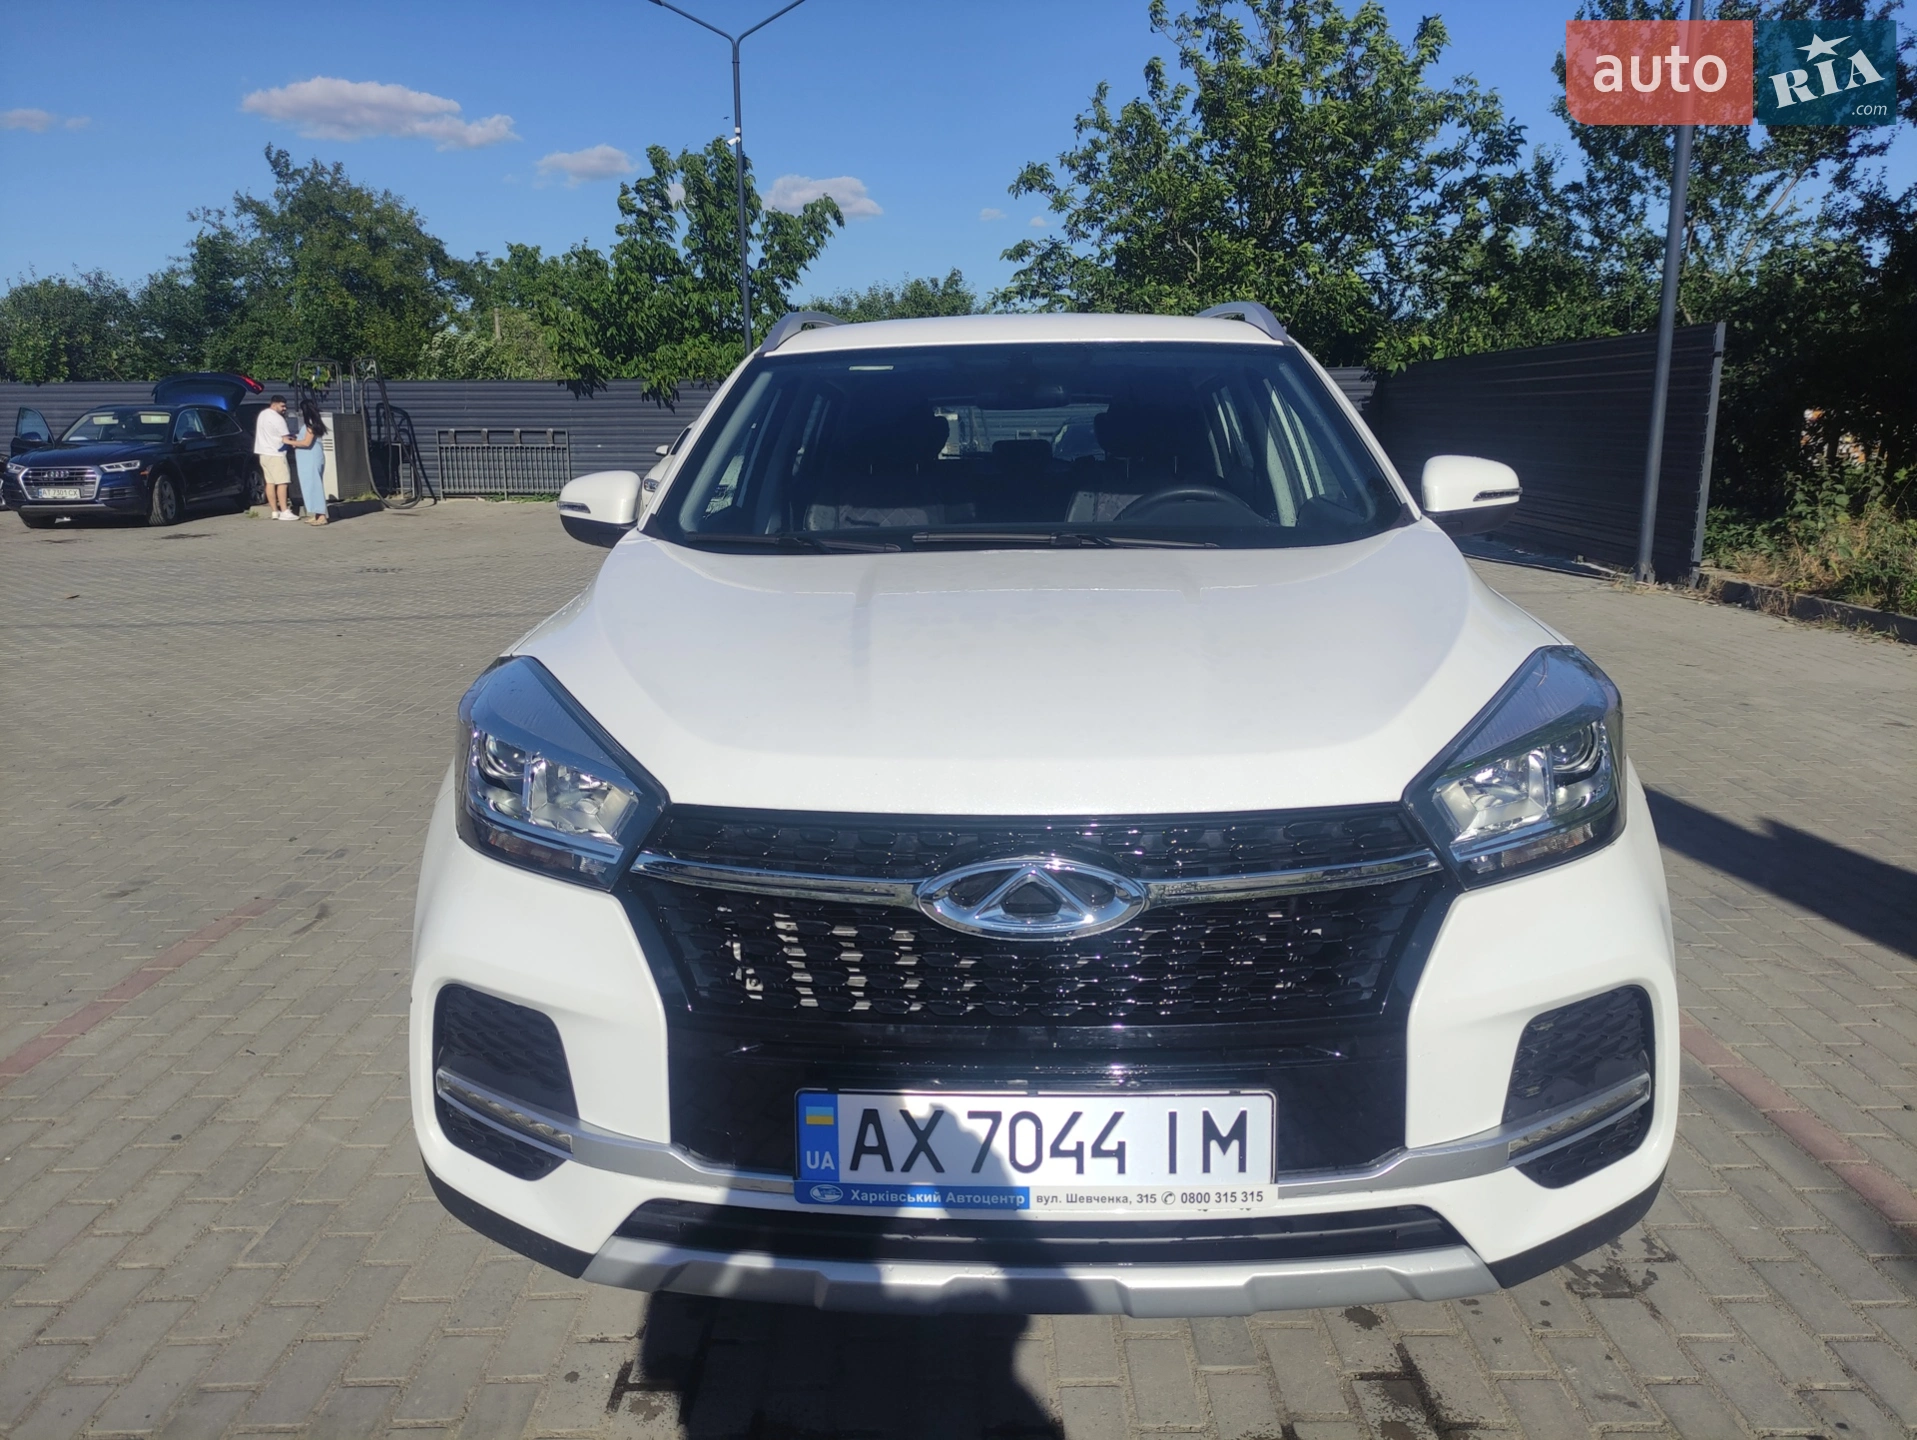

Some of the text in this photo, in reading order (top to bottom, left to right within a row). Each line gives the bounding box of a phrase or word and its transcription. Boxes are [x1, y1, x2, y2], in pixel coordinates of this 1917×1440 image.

[850, 1108, 1248, 1175] AX 7044 IM
[806, 1151, 835, 1170] UA
[851, 1188, 1025, 1206] Харківський Автоцентр
[1036, 1190, 1264, 1206] вул. Шевченка, 315 0800 315 315
